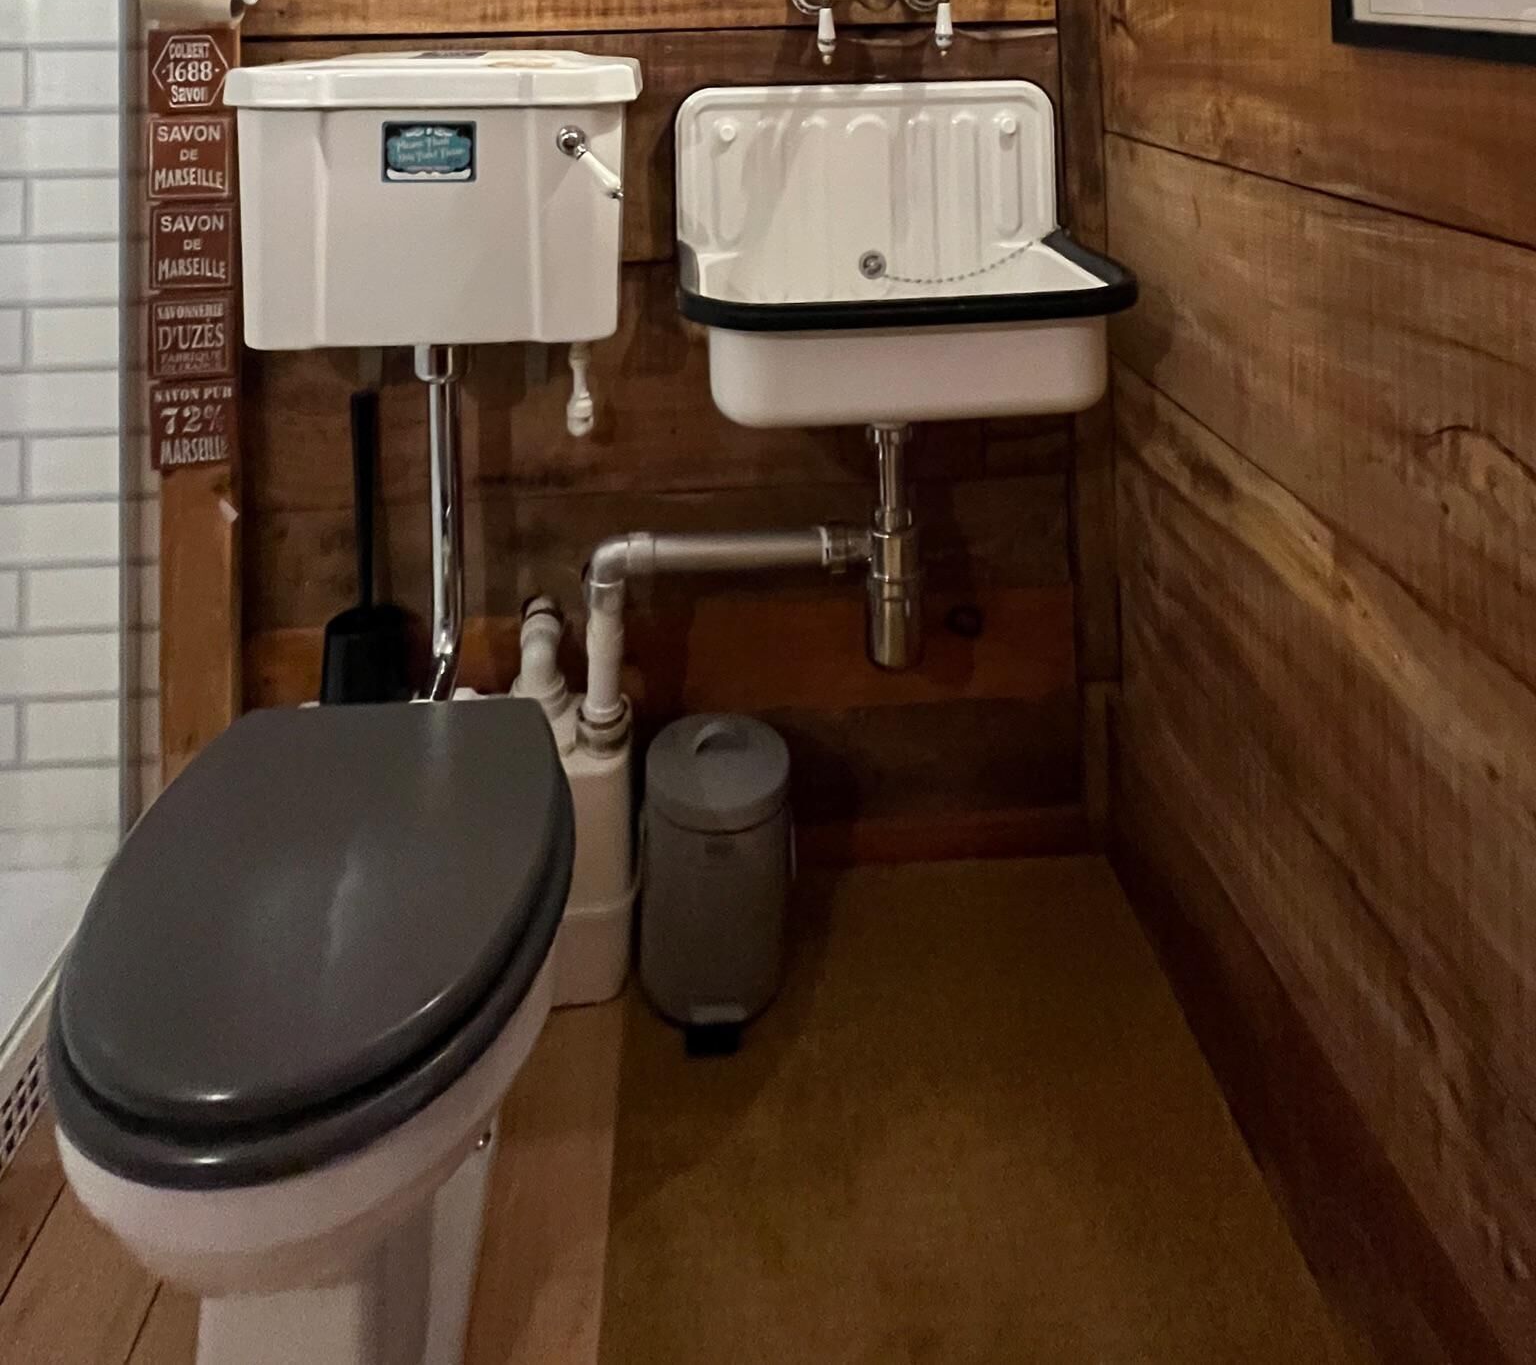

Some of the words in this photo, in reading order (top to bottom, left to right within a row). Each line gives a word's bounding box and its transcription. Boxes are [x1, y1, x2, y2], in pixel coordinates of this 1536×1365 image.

[169, 42, 211, 58] COLBERT
[166, 61, 213, 82] 1688
[171, 86, 208, 103] Savon
[157, 125, 221, 142] SAVON
[179, 149, 199, 161] DE
[155, 167, 225, 191] MARSEILLE
[160, 215, 225, 232] SAVON
[183, 239, 203, 250] DE
[158, 257, 226, 282] MARSEILLE
[157, 303, 225, 320] SAVONNERIE
[154, 388, 199, 403] SAVON
[203, 386, 233, 400] PUR
[160, 404, 225, 435] 72%
[160, 437, 230, 465] MARSEILLE
